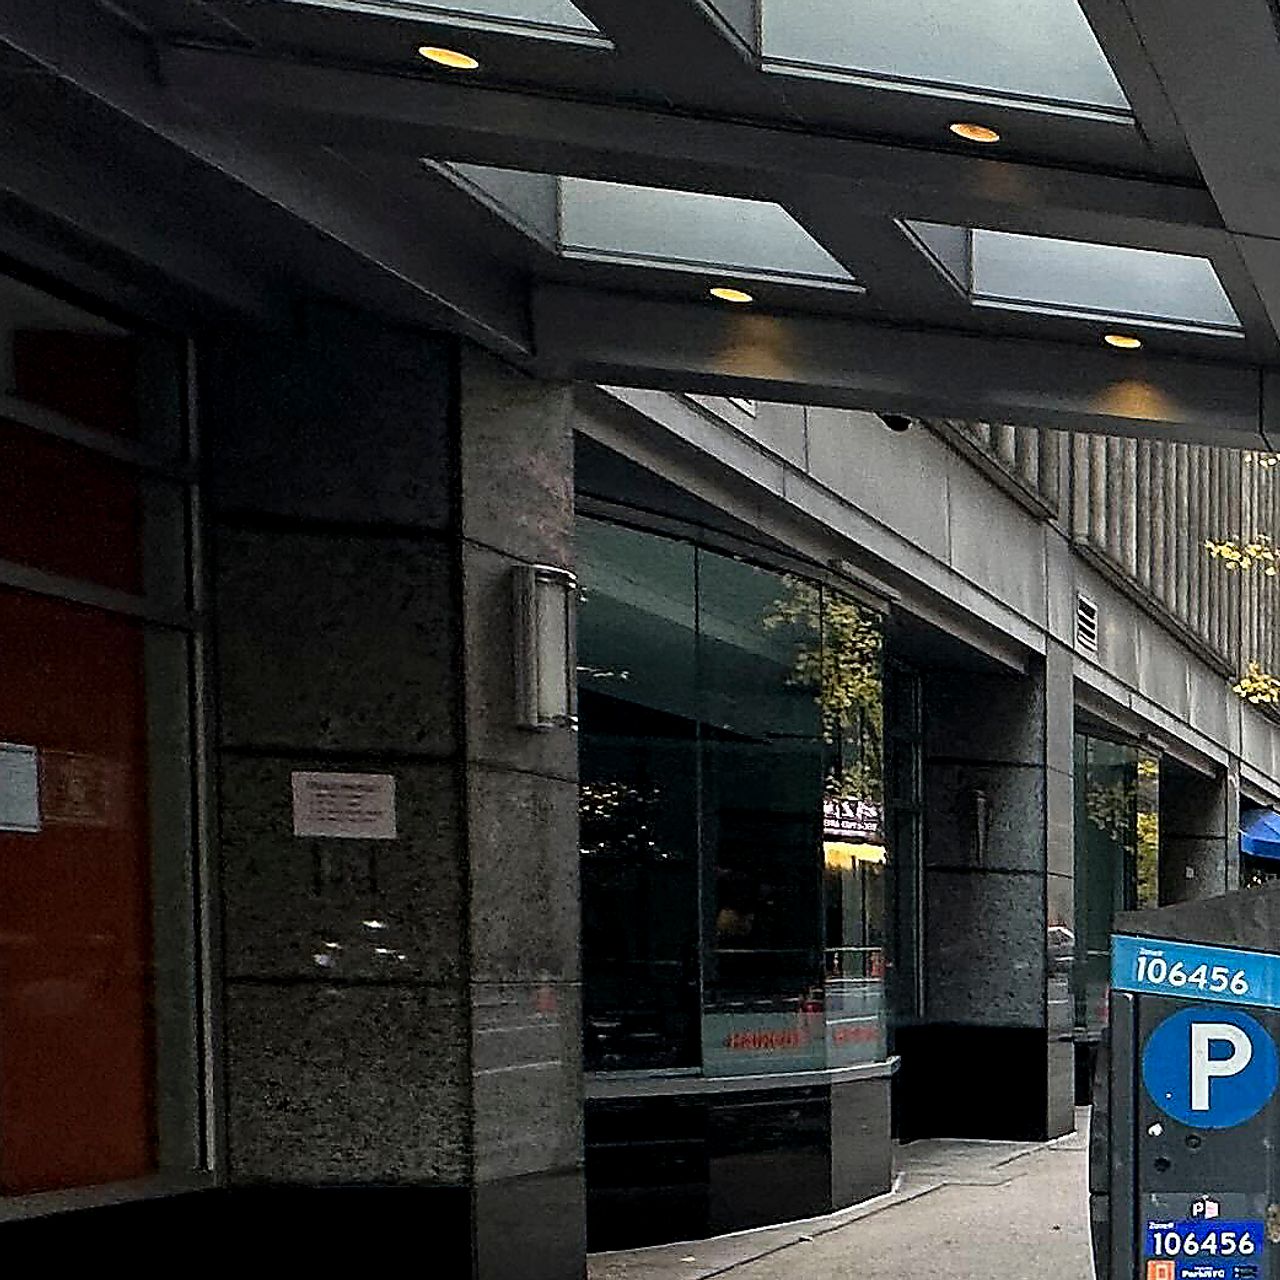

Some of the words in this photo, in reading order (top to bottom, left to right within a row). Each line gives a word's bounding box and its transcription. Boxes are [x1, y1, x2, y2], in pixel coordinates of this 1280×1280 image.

[1136, 954, 1249, 996] 106456
[1191, 1022, 1253, 1111] P
[1153, 1232, 1255, 1256] 106456
